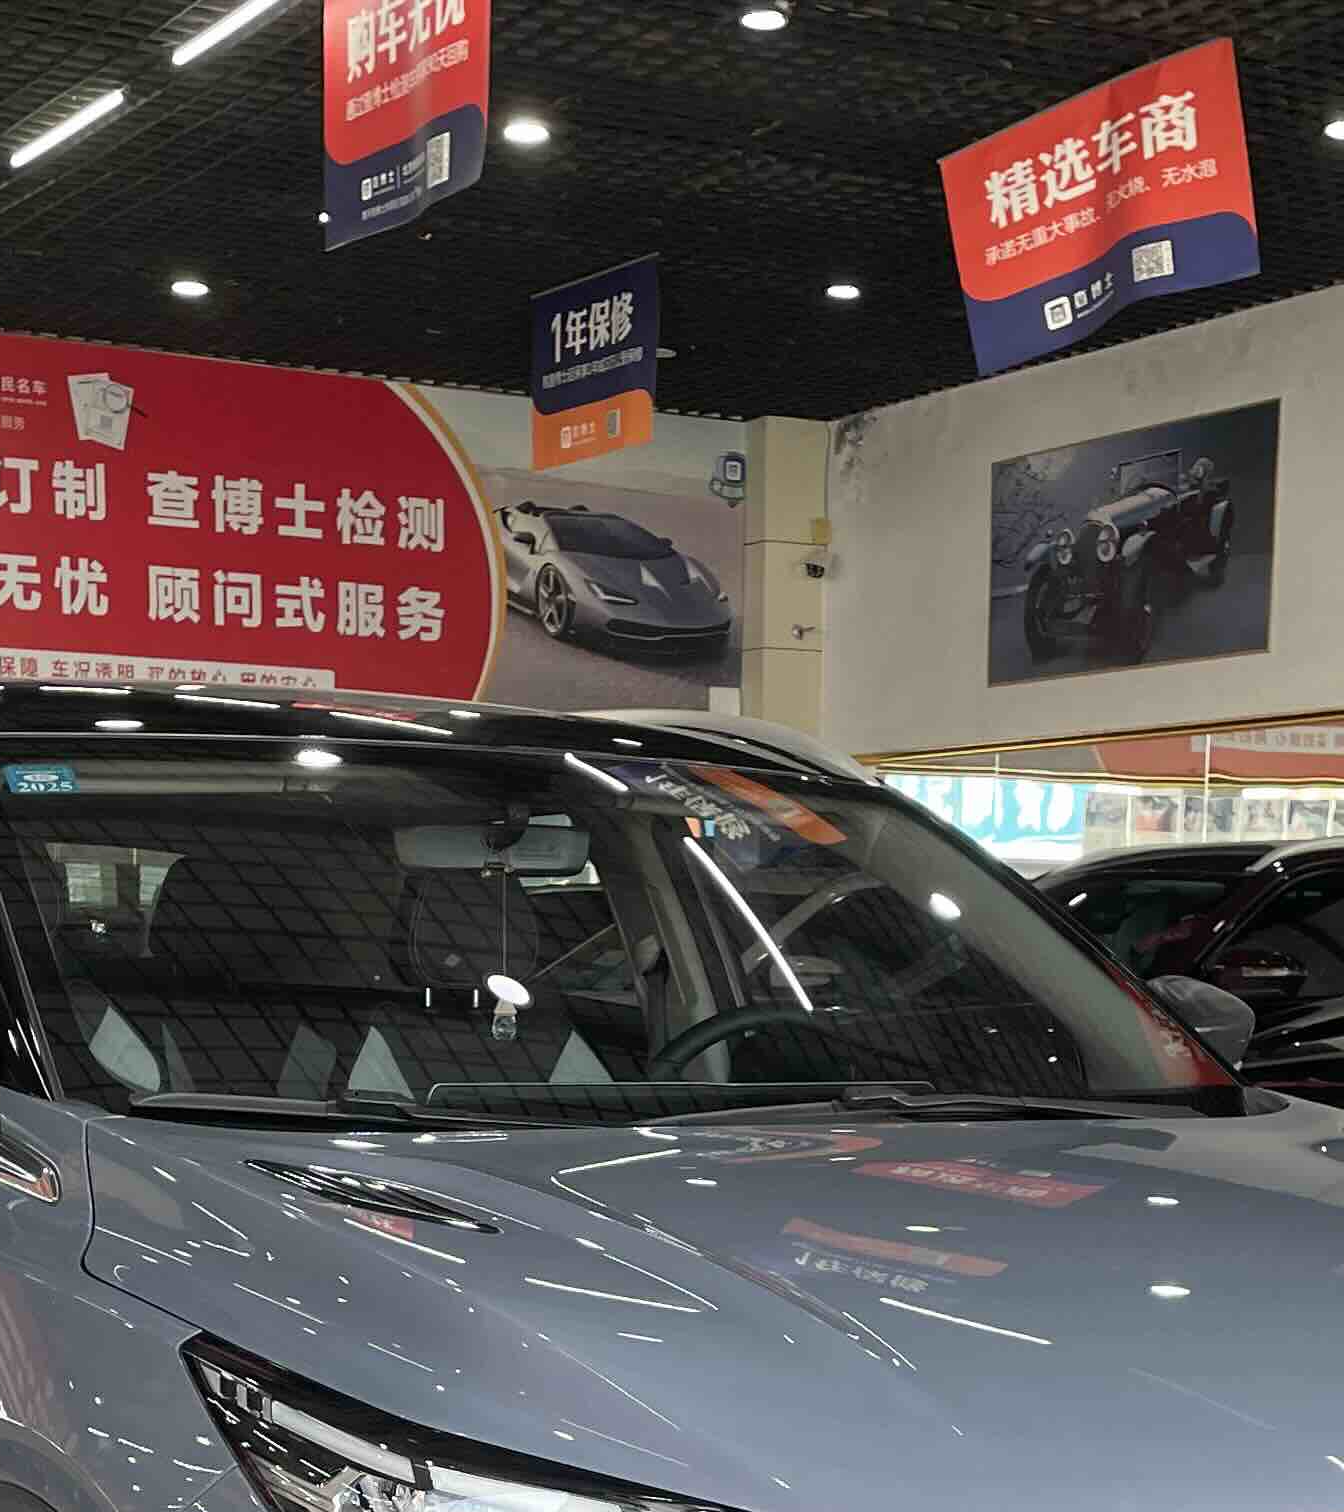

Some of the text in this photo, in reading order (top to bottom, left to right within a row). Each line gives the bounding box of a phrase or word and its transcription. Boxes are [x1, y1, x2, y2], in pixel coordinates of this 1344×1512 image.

[983, 90, 1198, 230] 精选车商
[551, 290, 635, 364] 1年保修
[145, 470, 447, 554] 查博士检测
[146, 564, 447, 643] 顾问式服务
